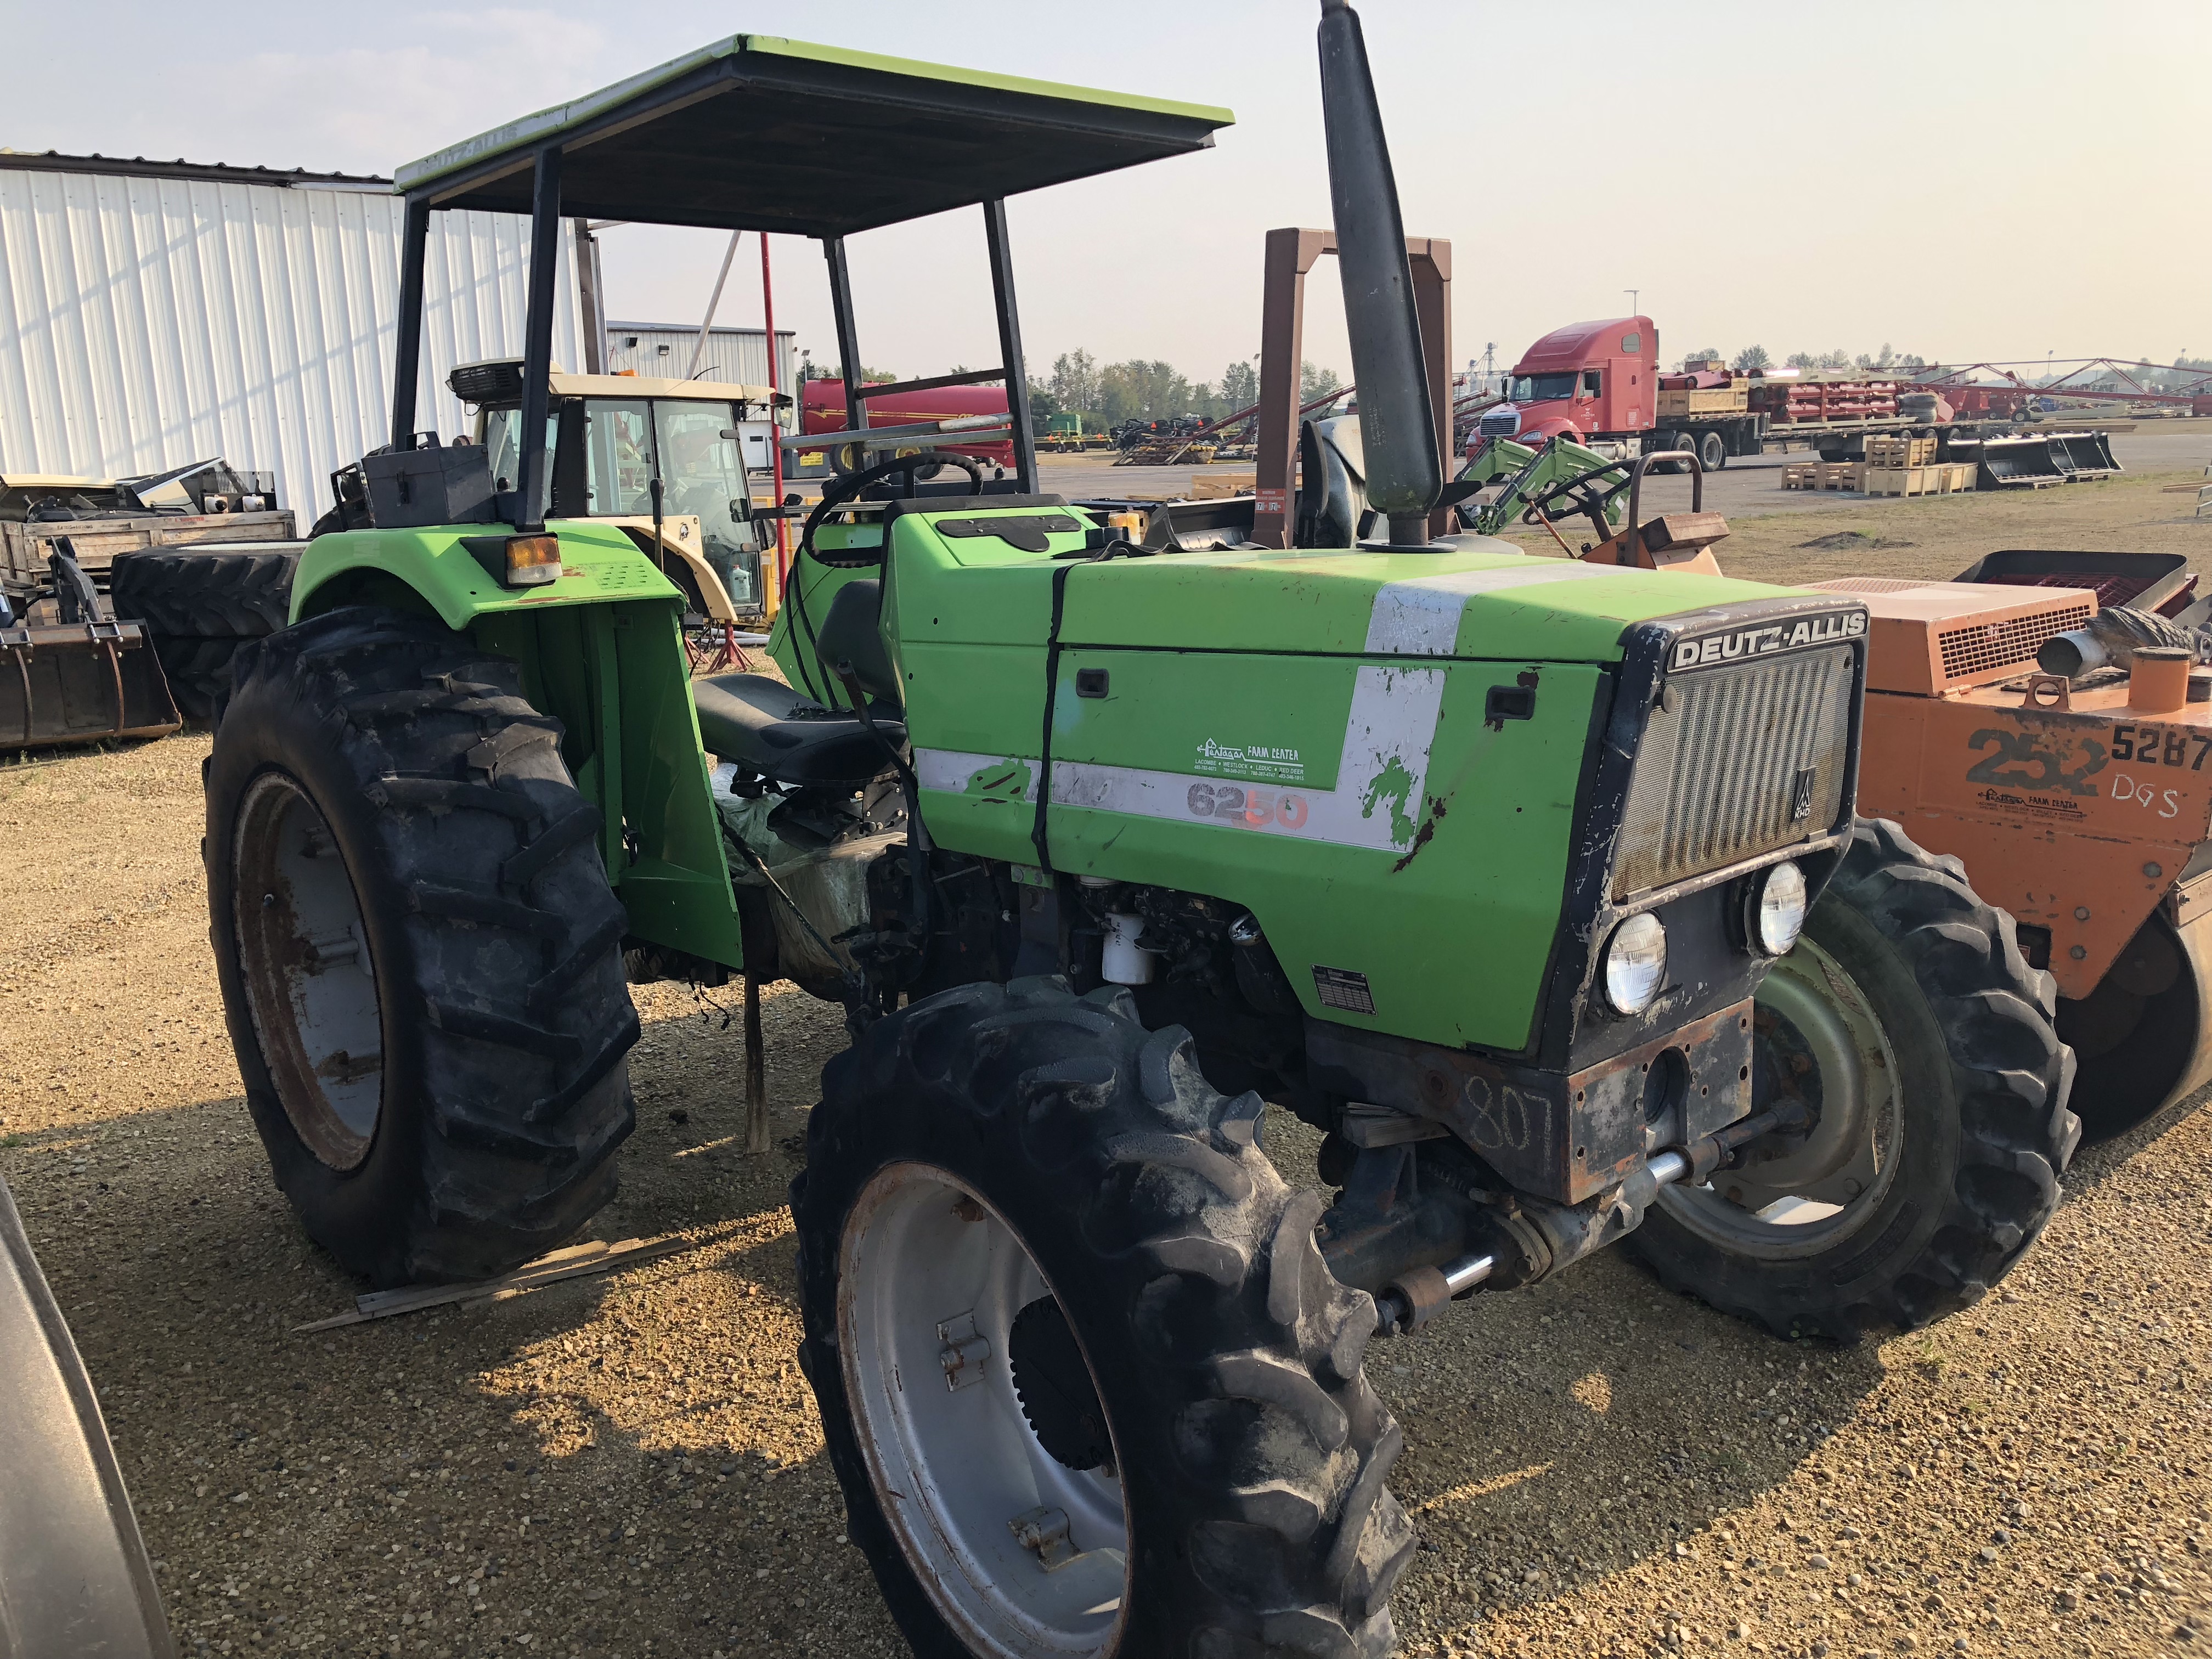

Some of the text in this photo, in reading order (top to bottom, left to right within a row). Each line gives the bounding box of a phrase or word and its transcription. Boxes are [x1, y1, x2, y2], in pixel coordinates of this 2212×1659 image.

[1674, 612, 1865, 668] DEUTZ-ALLIS
[1200, 737, 1299, 761] Pentagon FARM CENTER
[1223, 761, 1248, 769] WESTLOCK
[1966, 729, 2109, 797] 252
[2111, 725, 2212, 771] 5287
[1187, 782, 1308, 830] 6250
[1794, 808, 1810, 819] KHD
[2111, 773, 2179, 819] DGS
